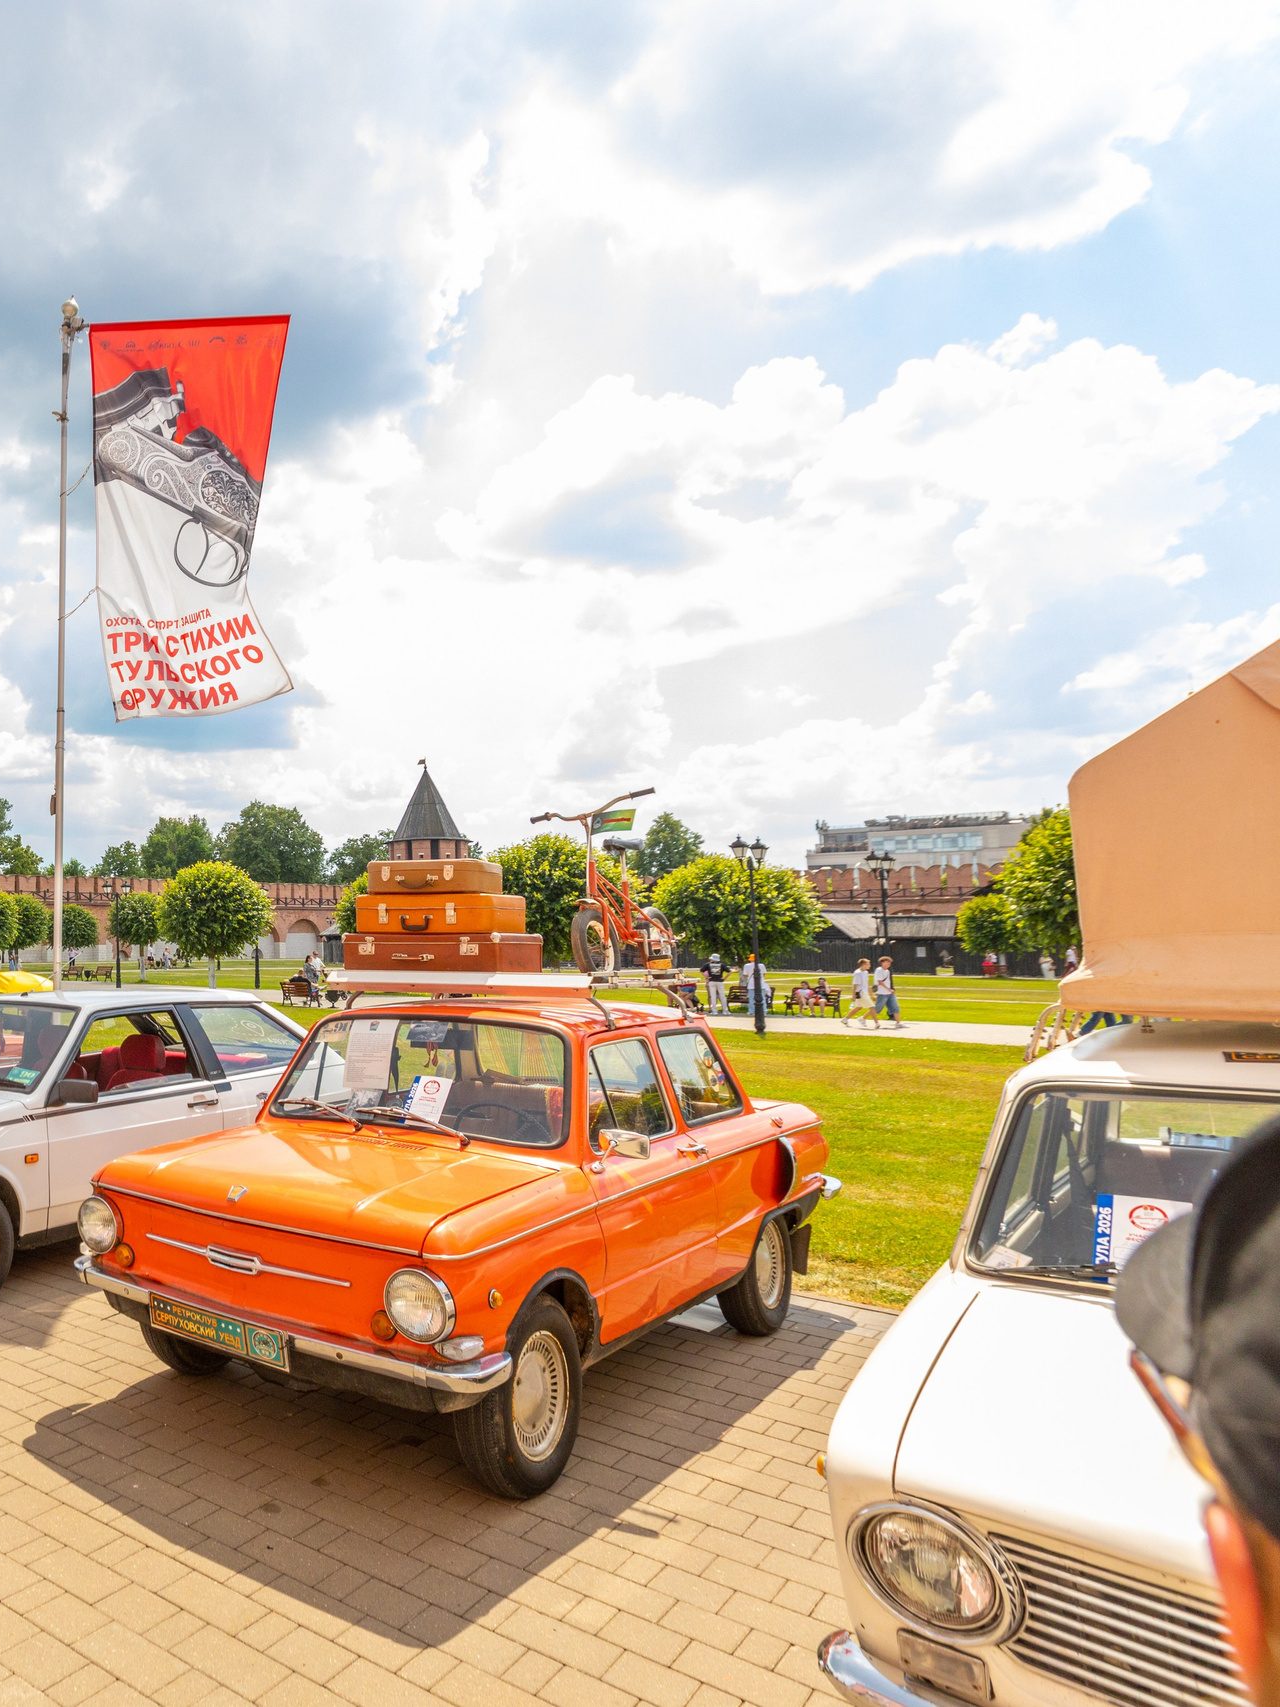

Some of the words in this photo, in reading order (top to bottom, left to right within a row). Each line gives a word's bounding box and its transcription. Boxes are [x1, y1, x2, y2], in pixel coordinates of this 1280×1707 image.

[180, 608, 212, 627] ЗАЩИТА
[107, 631, 160, 655] ТРИ
[165, 613, 257, 658] СТИХИИ
[110, 644, 264, 684] ТУЛЬСКОГО
[120, 681, 239, 711] ОРУЖИЯ
[1097, 1206, 1112, 1235] 2026
[156, 1310, 217, 1340] СЕРПУХОВСКИЙ
[219, 1331, 242, 1350] УЕЗД
[172, 1305, 218, 1328] РЕТРОКЛУБ
